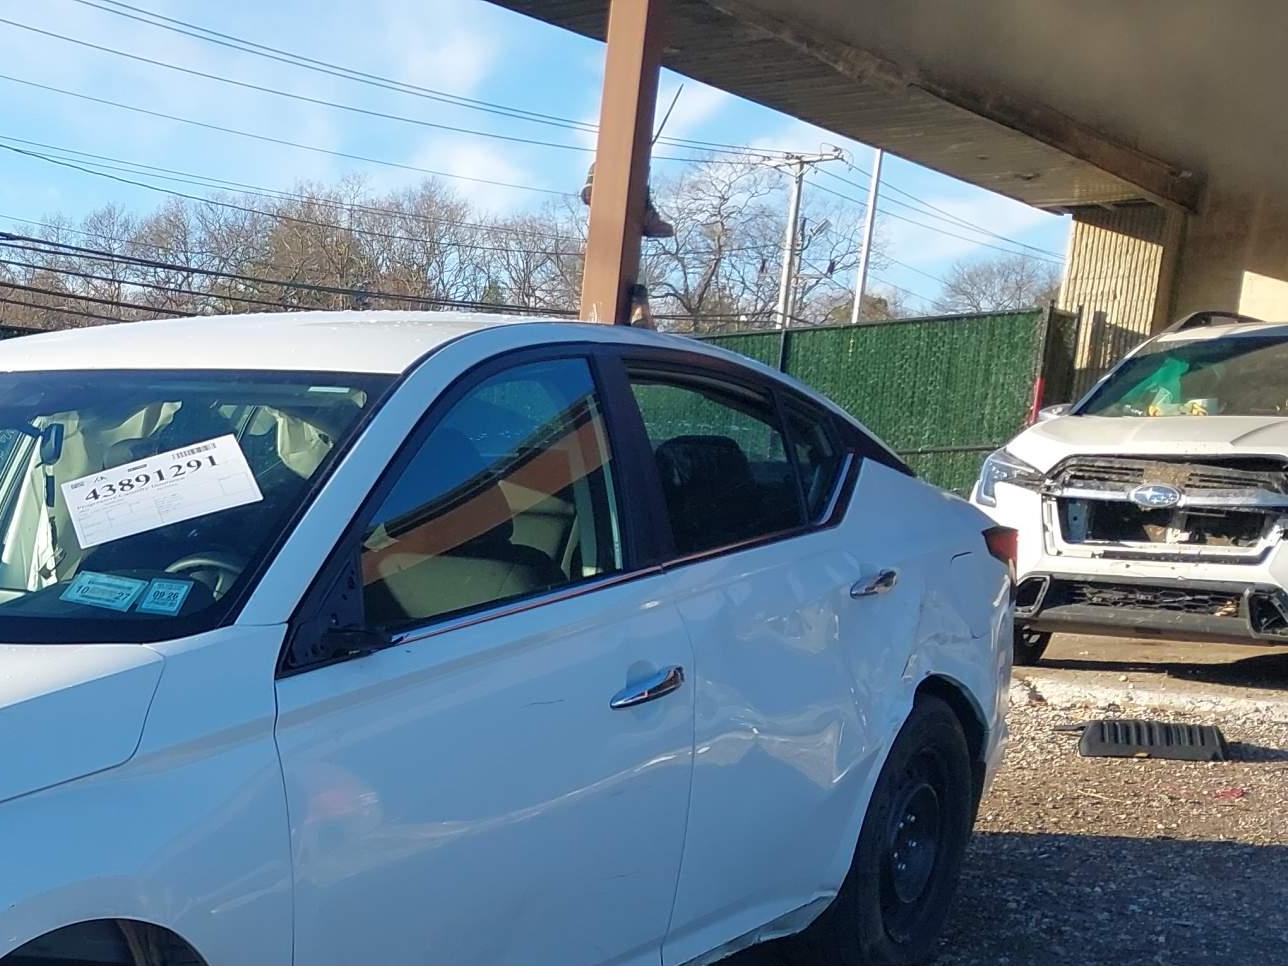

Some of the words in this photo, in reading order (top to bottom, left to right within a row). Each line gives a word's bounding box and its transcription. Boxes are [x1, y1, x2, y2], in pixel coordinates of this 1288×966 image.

[85, 455, 219, 501] 43891291
[76, 585, 90, 594] 10
[114, 592, 130, 601] 27
